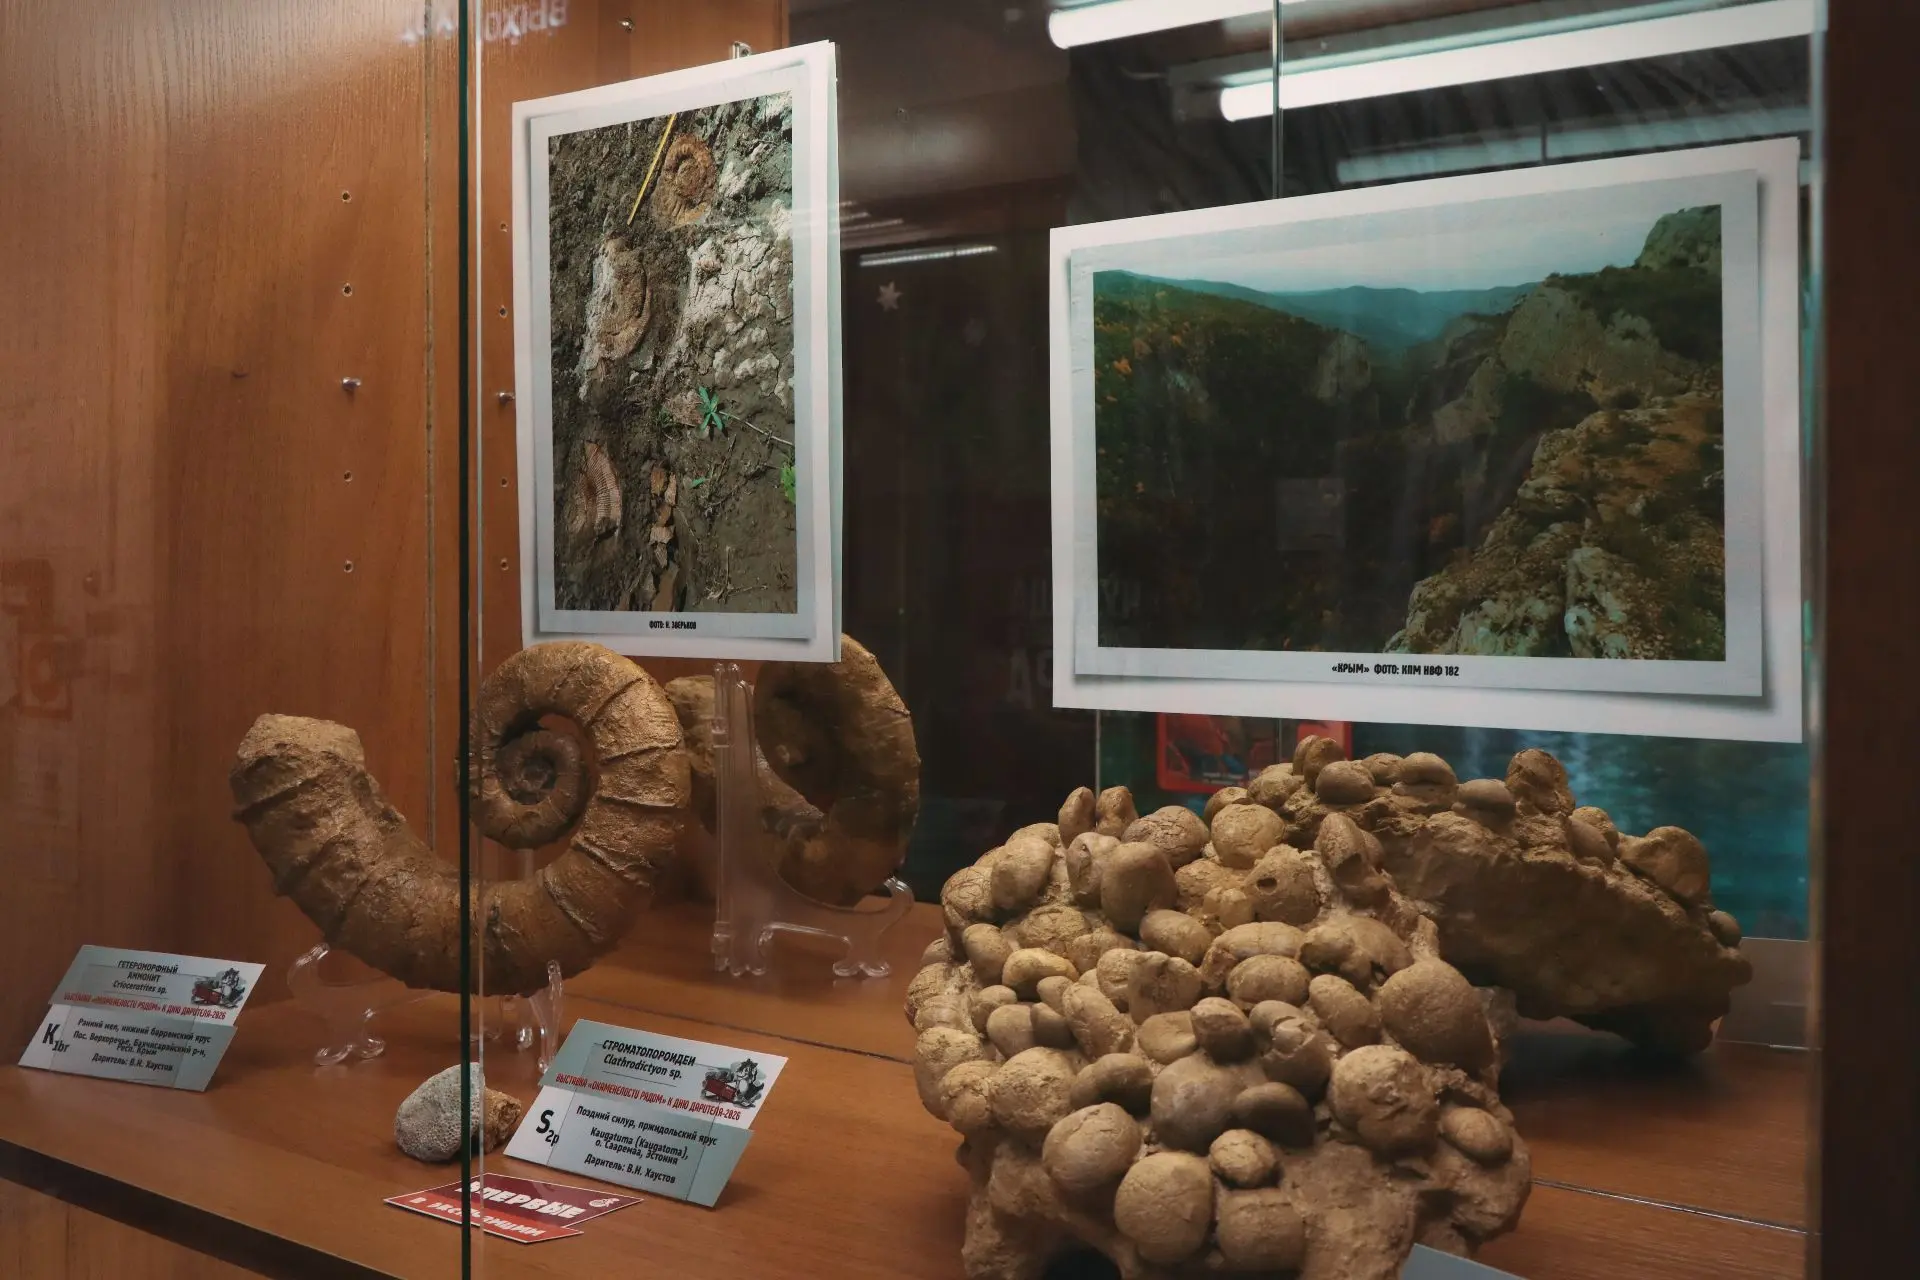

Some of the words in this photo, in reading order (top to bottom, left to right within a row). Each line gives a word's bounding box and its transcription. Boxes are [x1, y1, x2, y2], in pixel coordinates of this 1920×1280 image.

[649, 620, 664, 629] ФОТО:
[1331, 662, 1370, 674] «КРЫМ»
[1373, 663, 1400, 675] ФОТО:
[1401, 664, 1422, 676] КПМ
[1423, 665, 1443, 676] НВФ
[1444, 665, 1460, 677] 182
[117, 960, 179, 974] ГЕТЕРОМОРФНЫЙ
[127, 972, 161, 983] АММОНИТ
[112, 979, 156, 992] Crioceratites
[155, 985, 168, 995] sp.
[161, 1004, 167, 1012] К
[166, 1004, 182, 1015] ДНЮ
[78, 1018, 104, 1029] Ранний
[104, 1023, 119, 1032] мел,
[121, 1024, 150, 1035] нижний
[194, 1035, 212, 1044] ярус
[73, 1030, 88, 1039] Пос.
[191, 1048, 207, 1058] р-н,
[116, 1044, 136, 1054] Респ.
[136, 1047, 158, 1056] Крым
[602, 1039, 697, 1067] СТРОМАТОПОРОИДЕИ
[91, 1052, 128, 1065] Даритель:
[145, 1060, 174, 1072] Хаустов
[603, 1054, 668, 1076] Clathrodictyon
[668, 1069, 683, 1080] sp.
[555, 1072, 588, 1088] ВЫСТАВКА
[639, 1090, 667, 1105] РЯДОМ»
[667, 1096, 673, 1106] К
[672, 1098, 689, 1110] ДНЮ
[688, 1101, 741, 1121] ДАРИТЕЛЯ-2026
[576, 1105, 611, 1122] Поздний
[611, 1115, 636, 1129] силур,
[637, 1121, 698, 1141] пржидольский
[698, 1135, 718, 1146] ярус
[590, 1127, 634, 1145] Kaugatuma
[635, 1136, 689, 1160] (Kaugatoma),
[595, 1140, 602, 1148] о.
[604, 1140, 643, 1159] Сааремаа,
[645, 1151, 679, 1165] Эстония
[584, 1153, 626, 1171] Даритель:
[626, 1163, 642, 1175] В.Н.
[644, 1167, 676, 1184] Хаустов
